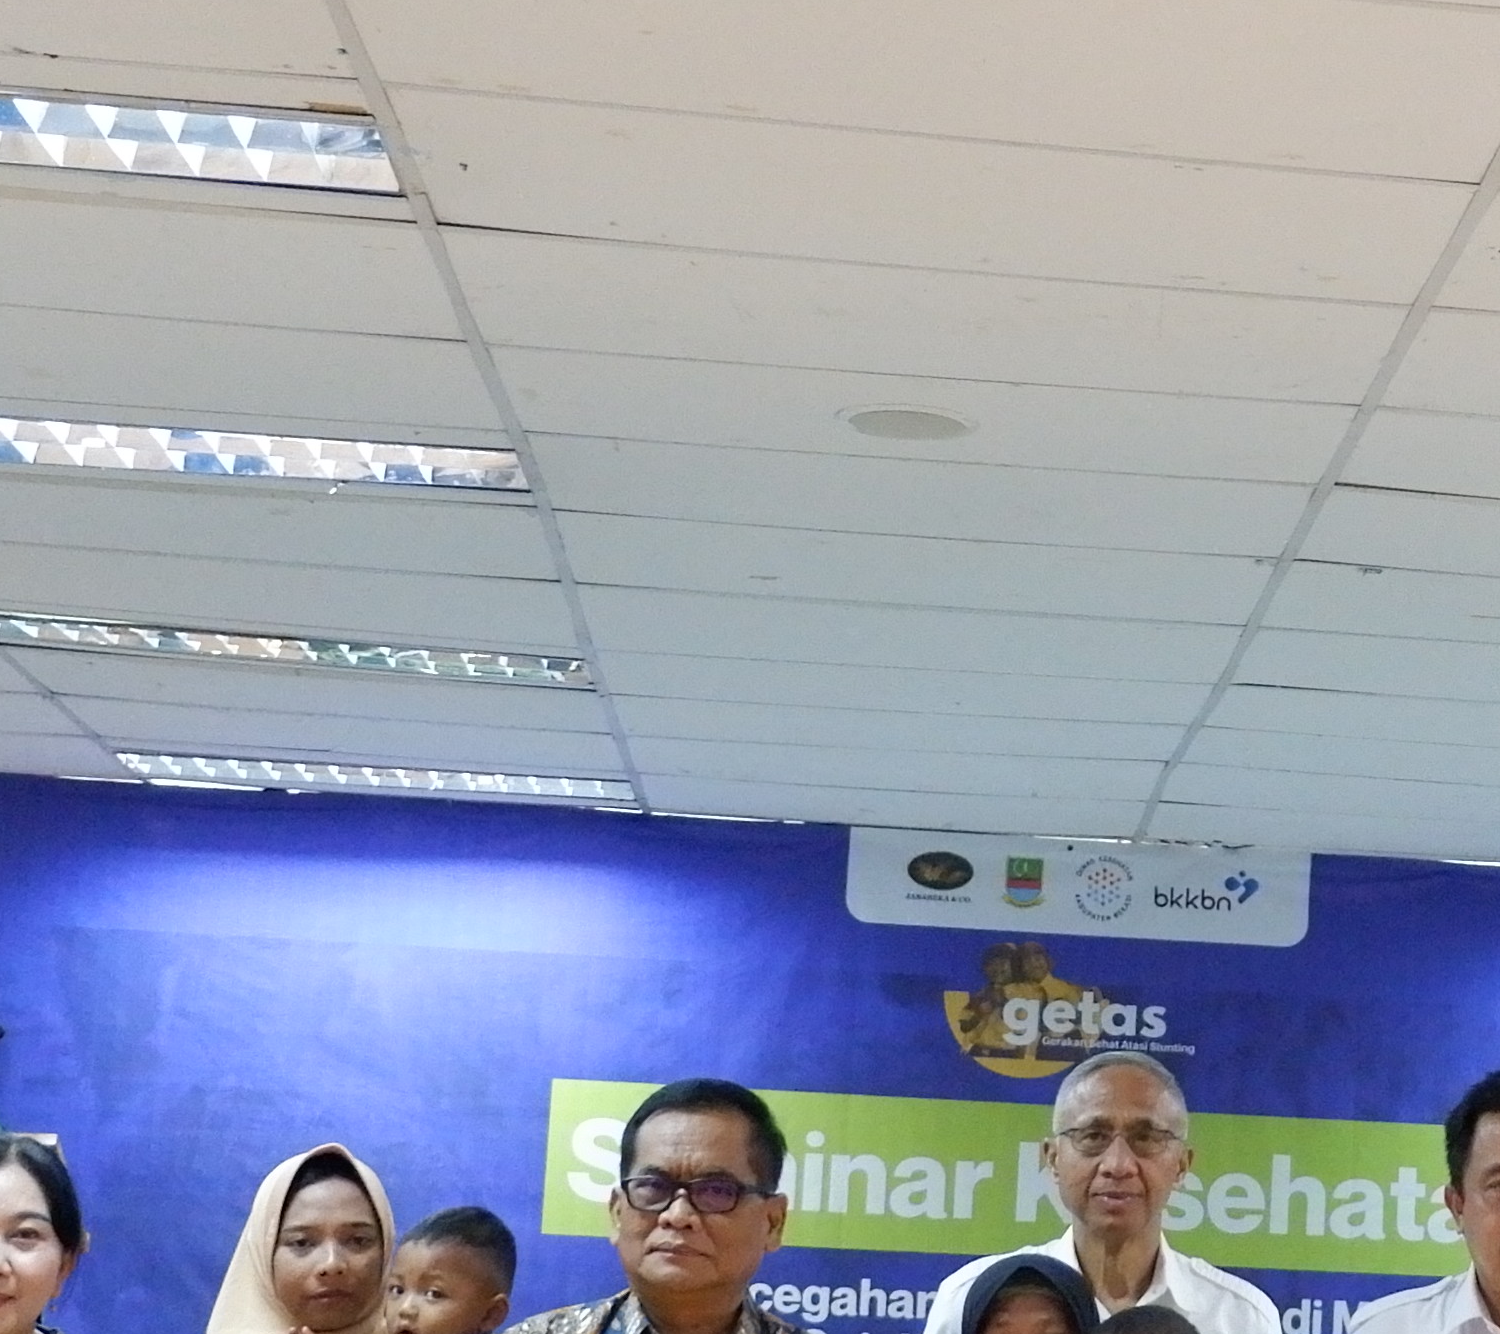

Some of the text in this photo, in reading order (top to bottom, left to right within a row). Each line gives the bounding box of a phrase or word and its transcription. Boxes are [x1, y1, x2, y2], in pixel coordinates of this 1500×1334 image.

[1154, 885, 1231, 911] bkkbn
[1003, 991, 1167, 1046] getas
[1149, 1042, 1195, 1056] Stunting
[567, 1117, 994, 1220] Sinar
